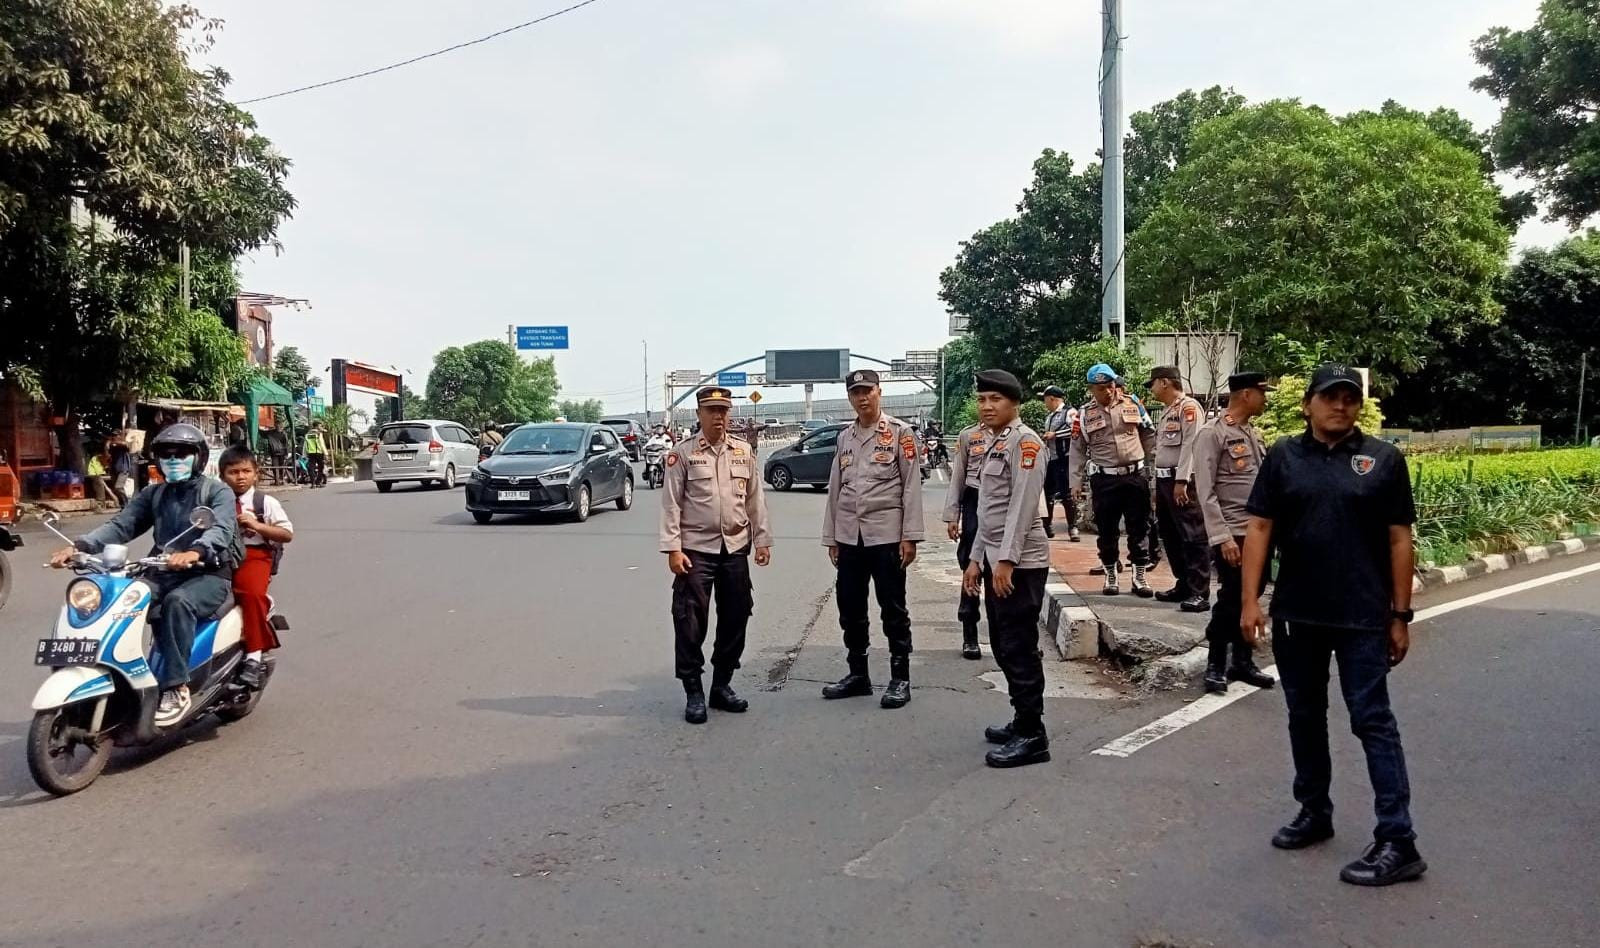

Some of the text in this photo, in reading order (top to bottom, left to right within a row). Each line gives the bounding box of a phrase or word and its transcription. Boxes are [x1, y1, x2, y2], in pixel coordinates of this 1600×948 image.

[39, 641, 97, 653] B 3480 TNF
